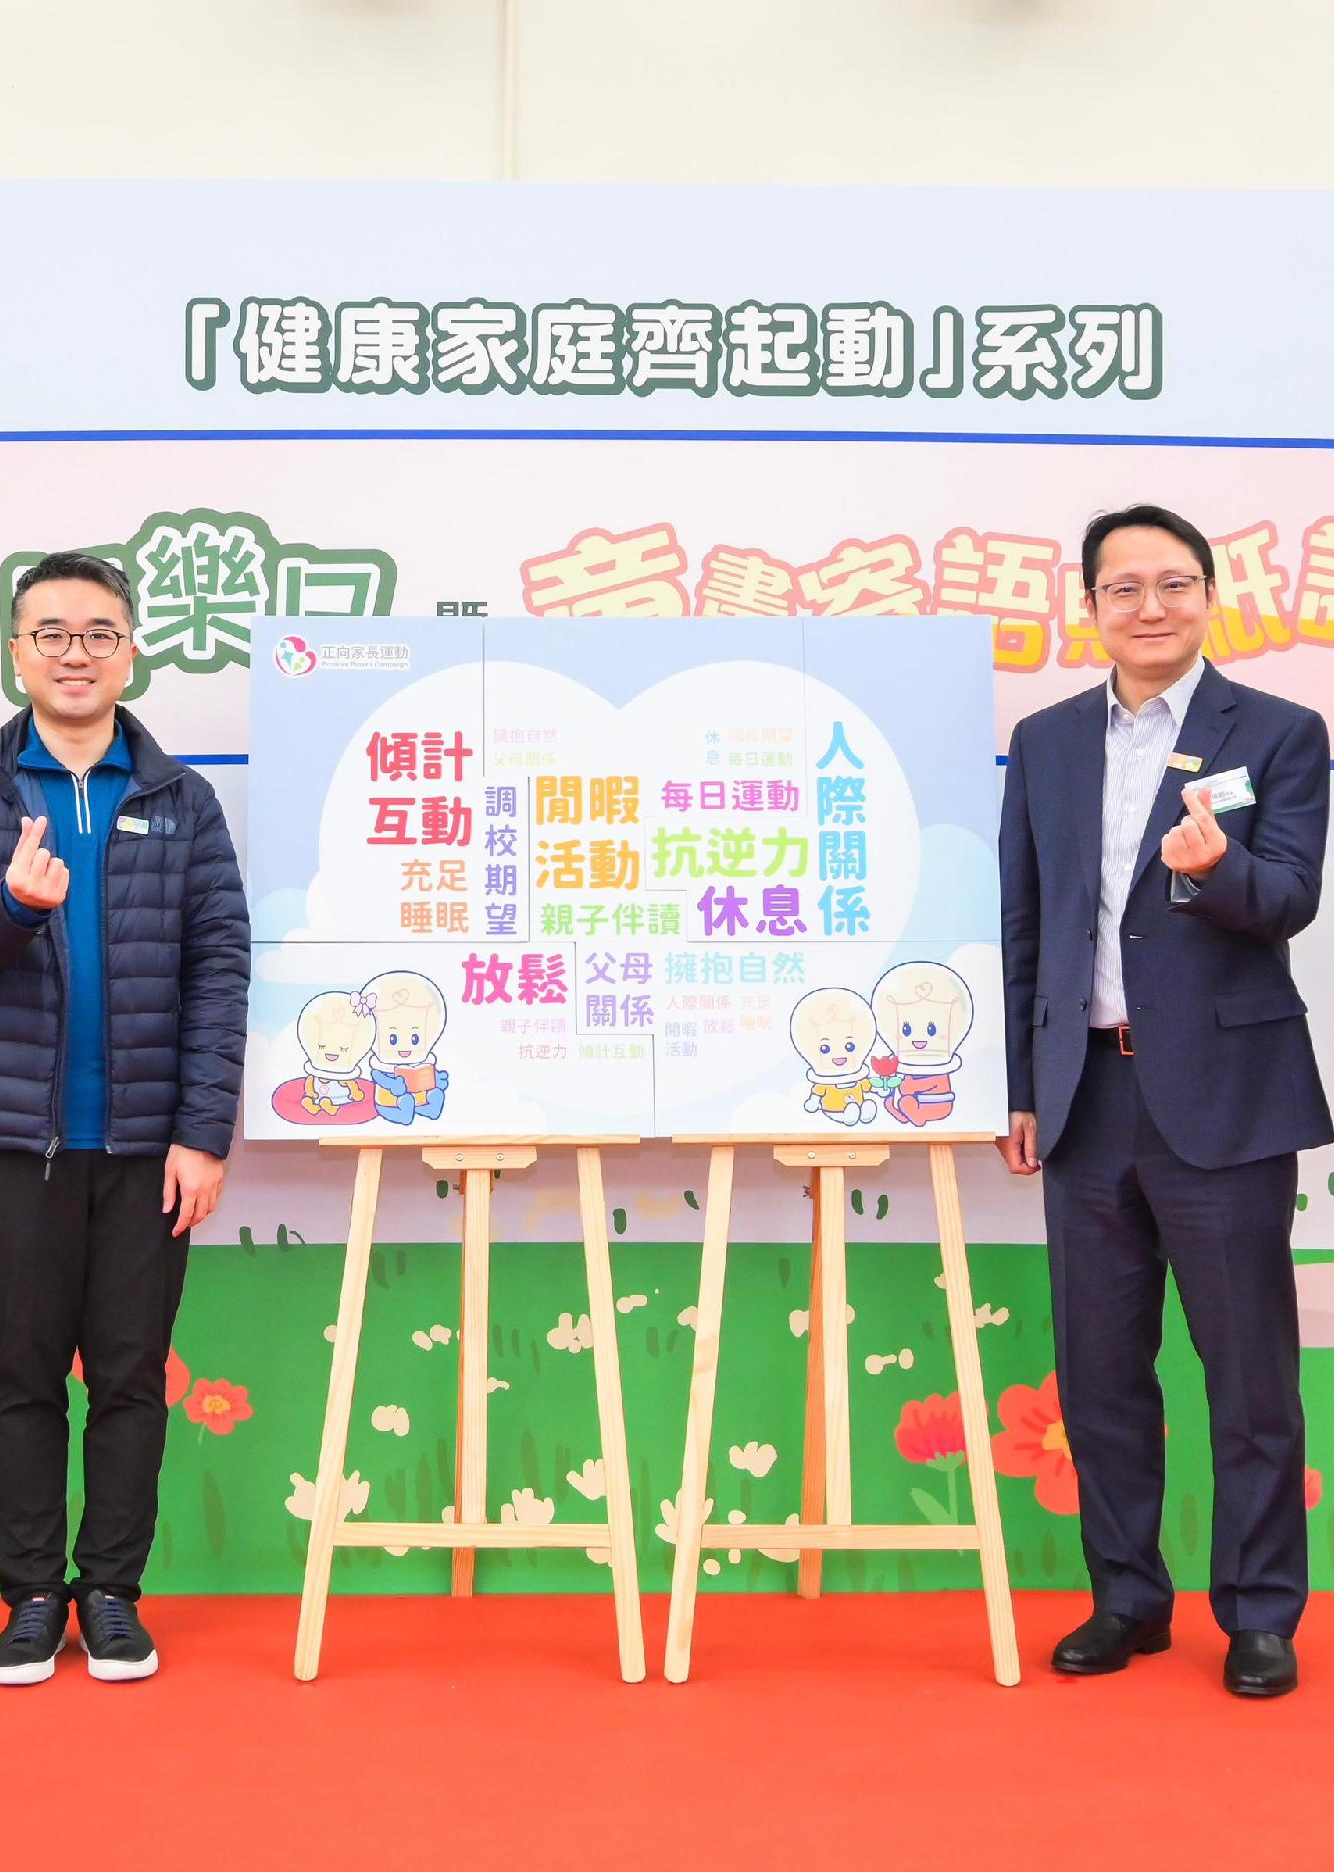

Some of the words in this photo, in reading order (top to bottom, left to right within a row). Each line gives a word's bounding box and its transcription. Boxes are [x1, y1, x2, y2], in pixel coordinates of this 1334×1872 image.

[182, 299, 1156, 393] 「健康家庭齊起動」系列
[322, 645, 408, 659] 正向家長運動
[493, 728, 558, 744] 擁抱自然
[366, 731, 473, 781] 傾計
[729, 751, 793, 767] 每日運動
[661, 780, 799, 812] 每日運動
[367, 796, 472, 846] 互動
[816, 721, 871, 936] 人際關係
[484, 786, 517, 935] 調校期望
[535, 839, 640, 891] 活動
[651, 826, 809, 878] 抗逆力
[401, 859, 468, 892] 充足
[401, 901, 469, 933] 睡眠
[540, 904, 680, 936] 親子伴讀
[697, 884, 807, 936] 休息
[461, 952, 568, 1005] 放鬆
[584, 952, 653, 985] 父母
[664, 951, 806, 985] 擁抱自然
[501, 1018, 566, 1034] 親子伴讀
[585, 995, 655, 1028] 關係
[519, 1044, 567, 1060] 抗逆力
[665, 1041, 698, 1057] 活動
